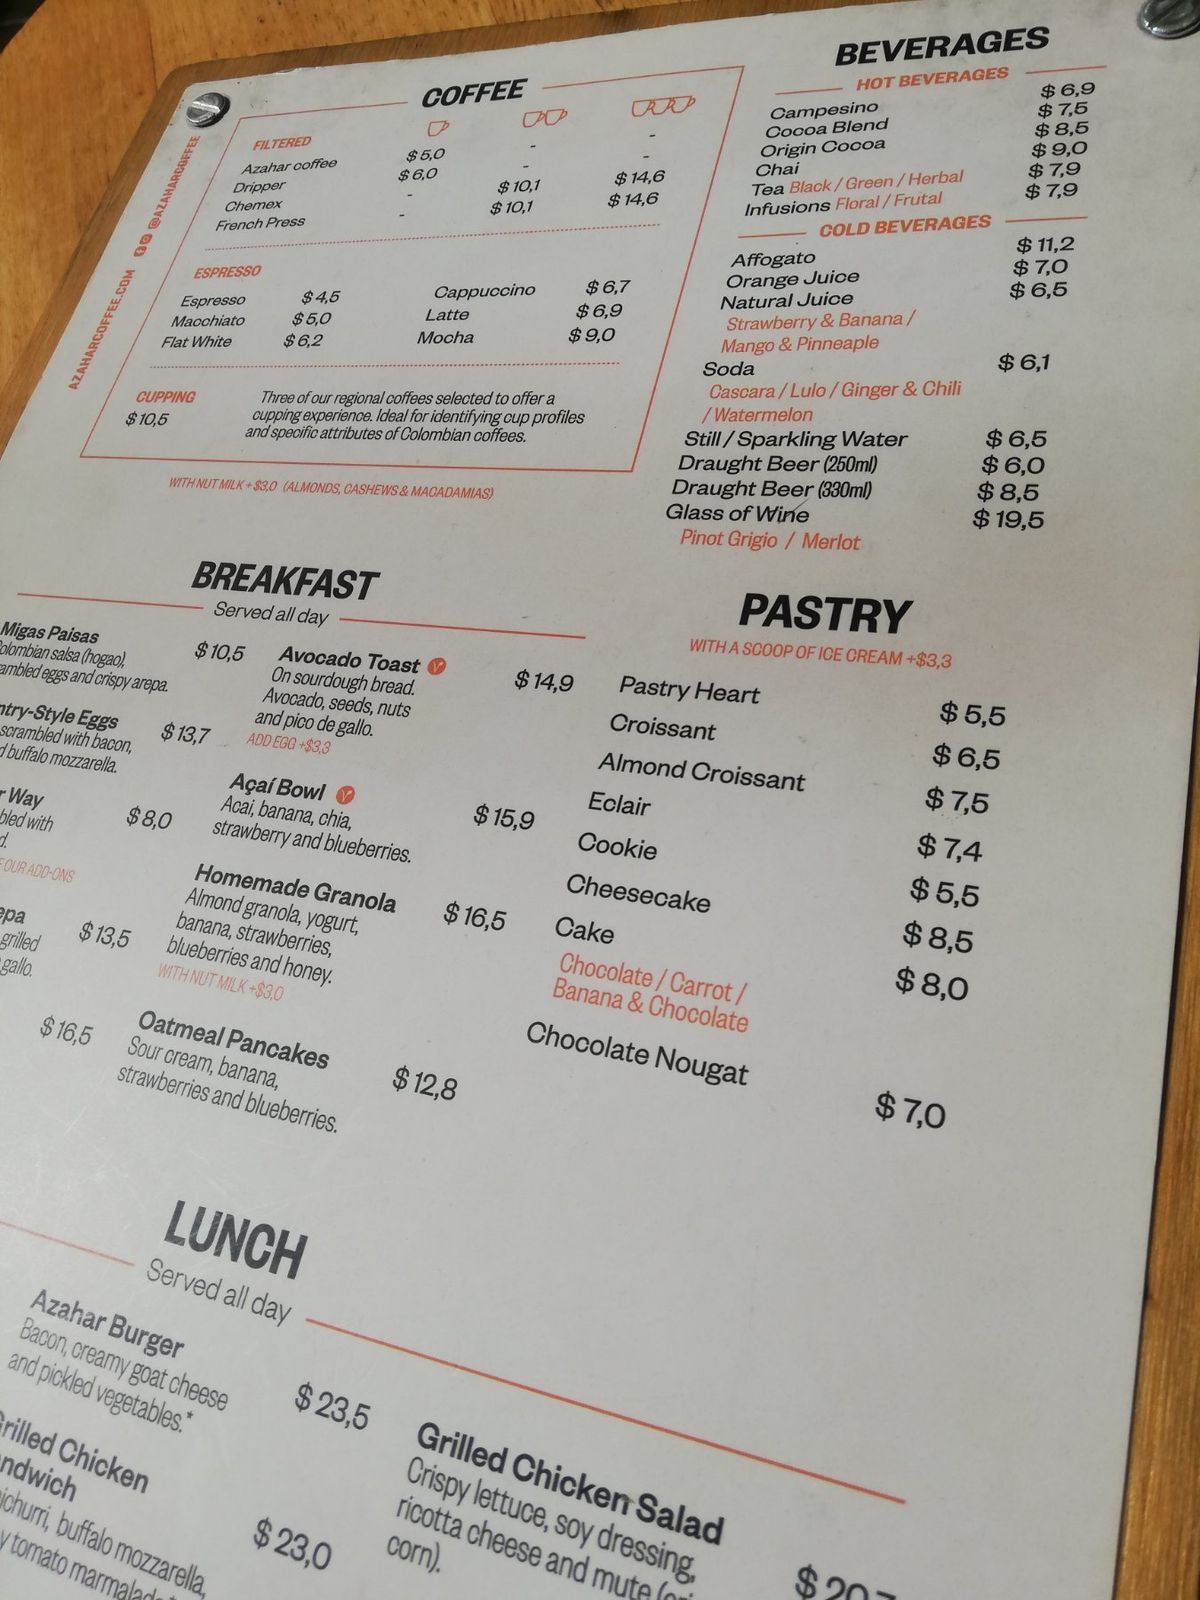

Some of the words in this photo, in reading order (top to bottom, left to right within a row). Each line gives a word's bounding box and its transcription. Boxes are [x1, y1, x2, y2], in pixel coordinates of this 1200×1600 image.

[835, 26, 1050, 67] BEVERAGES
[856, 76, 896, 91] HOT
[898, 66, 1009, 88] BEVERAGES
[422, 78, 529, 108] COFFEE
[770, 101, 879, 120] Campesino
[765, 125, 827, 139] Cocoa
[832, 117, 889, 134] Blend
[253, 136, 312, 151] FILTERED
[760, 142, 817, 159] Origin
[821, 139, 886, 153] Cocoa
[241, 162, 292, 175] Azahar
[293, 158, 338, 171] coffee
[755, 161, 800, 177] Chai
[233, 181, 287, 195] Dripper
[751, 183, 785, 197] Tea
[789, 179, 832, 194] Black
[846, 177, 893, 190] Green
[908, 169, 964, 186] Herbal
[225, 200, 283, 213] Chemex
[744, 200, 831, 217] Infusions
[835, 195, 880, 210] Floral
[894, 191, 943, 207] Frutal
[215, 218, 263, 232] French
[265, 217, 306, 228] Press
[819, 222, 871, 238] COLD
[874, 214, 992, 234] BEVERAGES
[194, 265, 262, 279] ESPRESSO
[730, 252, 816, 269] Affogato
[726, 274, 799, 290] Orange
[803, 270, 860, 285] Juice
[180, 295, 246, 309] Espresso
[434, 283, 536, 301] Cappuccino
[720, 293, 794, 310] Natural
[797, 291, 854, 307] Juice
[171, 314, 246, 328] Macchiato
[425, 308, 470, 322] Latte
[727, 315, 818, 331] Strawberry
[820, 313, 835, 328] &
[839, 312, 903, 327] Banana
[68, 270, 135, 390] AZAHARCOFFEE.COM
[161, 336, 190, 348] Flat
[192, 335, 232, 348] White
[417, 330, 474, 344] Mocha
[721, 339, 775, 356] Mango
[778, 337, 792, 352] &
[796, 335, 879, 353] Pinneaple
[702, 361, 755, 377] Soda
[136, 391, 196, 403] CUPPING
[261, 390, 295, 404] Three
[296, 390, 313, 404] of
[311, 394, 334, 404] our
[333, 391, 386, 408] regional
[386, 391, 434, 405] coffees
[435, 391, 494, 405] selected
[495, 392, 510, 405] to
[511, 390, 545, 405] offer
[546, 394, 555, 405] a
[252, 408, 303, 425] cupping
[302, 408, 373, 425] experience.
[375, 408, 410, 423] Ideal
[409, 408, 430, 423] for
[430, 408, 503, 427] identifying
[503, 413, 530, 427] cup
[531, 409, 586, 427] profiles
[245, 424, 271, 438] and
[270, 425, 319, 441] specific
[319, 425, 383, 440] attributes
[384, 426, 402, 441] of
[400, 426, 472, 442] Colombian
[473, 427, 526, 443] coffees.
[684, 430, 722, 447] Still
[737, 430, 838, 451] Sparkling
[842, 430, 909, 447] Water
[678, 454, 763, 475] Draught
[766, 455, 821, 472] Beer
[823, 455, 878, 475] (250ml)
[671, 479, 757, 500] Draught
[760, 480, 815, 497] Beer
[818, 480, 872, 500] (330ml)
[666, 503, 724, 521] Glass
[729, 505, 754, 522] of
[755, 505, 810, 523] Wine
[191, 560, 381, 601] BREAKFAST
[214, 601, 275, 620] Served
[275, 606, 297, 622] all
[297, 608, 330, 628] day
[738, 592, 914, 634] PASTRY
[0, 621, 46, 641] Migas
[46, 625, 100, 644] Paisas
[278, 646, 362, 669] Avocado
[368, 653, 421, 674] Toast
[271, 666, 292, 683] On
[293, 671, 368, 694] sourdough
[370, 675, 415, 696] bread.
[619, 675, 692, 702] Pastry
[694, 681, 761, 704] Heart
[610, 713, 717, 741] Croissant
[597, 752, 688, 779] Almond
[691, 761, 806, 792] Croissant
[228, 773, 278, 796] Açaí
[276, 778, 327, 801] Bowl
[220, 795, 255, 818] Acai,
[257, 799, 314, 826] banana,
[318, 809, 352, 832] chia,
[588, 791, 652, 816] Eclair
[578, 832, 658, 861] Cookie
[194, 863, 310, 898] Homemade
[314, 882, 396, 913] Granola
[566, 873, 711, 913] Cheesecake
[184, 887, 245, 913] Almond
[241, 902, 301, 927] granola,
[305, 911, 359, 938] yogurt,
[555, 916, 615, 944] Cake
[138, 1010, 226, 1046] Oatmeal
[225, 1029, 330, 1069] Pancakes
[527, 1021, 650, 1065] Chocolate
[654, 1045, 750, 1086] Nougat
[164, 1200, 309, 1280] LUNCH
[147, 1258, 223, 1301] Served
[223, 1285, 250, 1310] all
[251, 1292, 292, 1327] day
[30, 1289, 107, 1331] Azahar
[108, 1313, 185, 1358] Burger
[417, 1422, 509, 1474] Grilled
[512, 1453, 635, 1516] Chicken
[635, 1493, 725, 1546] Salad
[407, 1456, 472, 1506] Crispy
[473, 1478, 549, 1533] lettuce,
[554, 1514, 595, 1549] soy
[597, 1532, 696, 1585] dressing,
[387, 1535, 440, 1573] corn).
